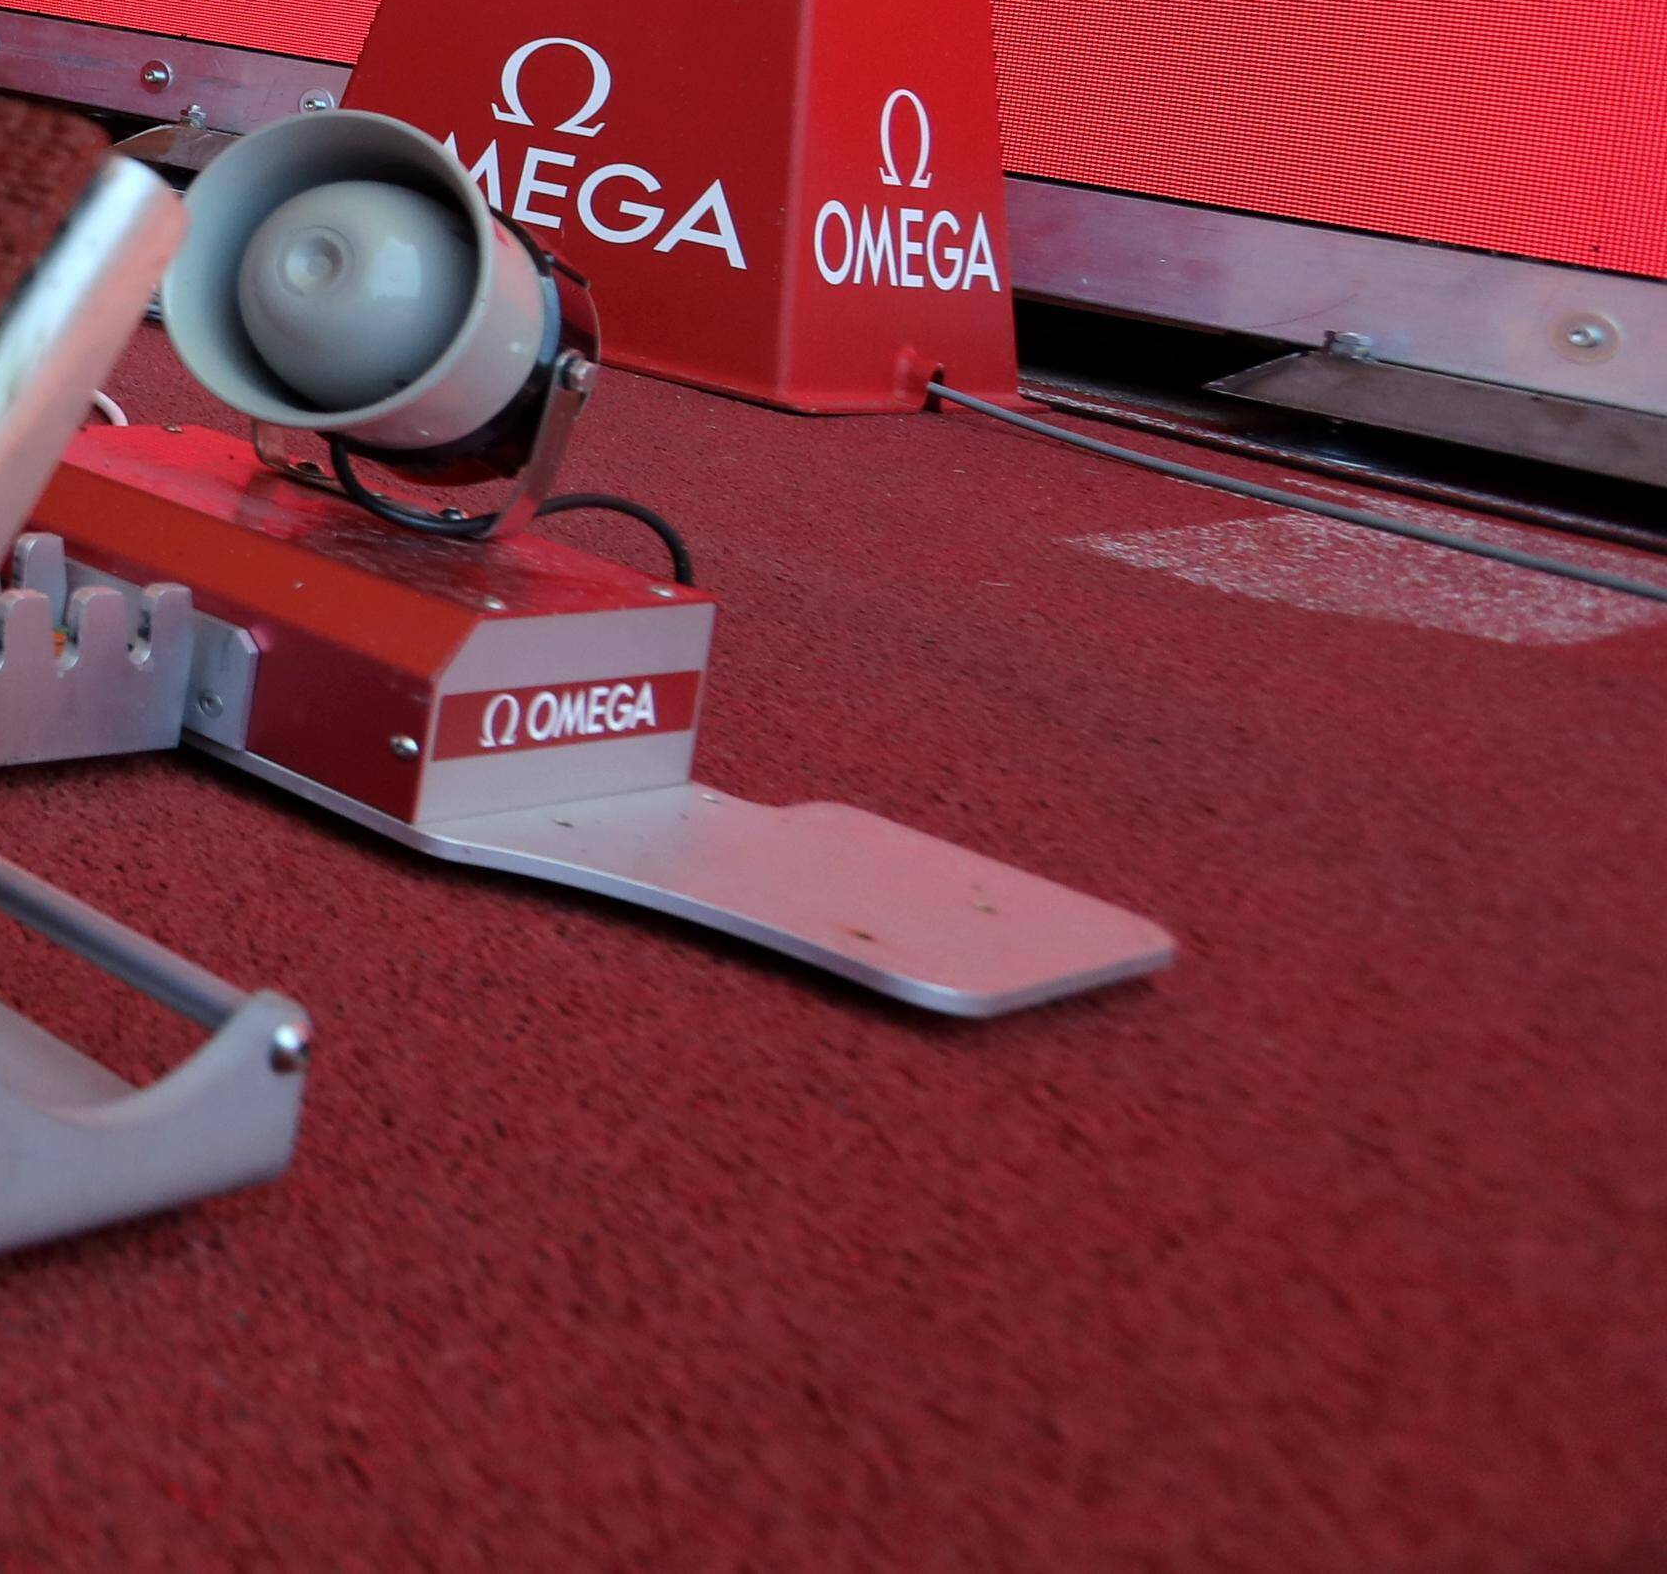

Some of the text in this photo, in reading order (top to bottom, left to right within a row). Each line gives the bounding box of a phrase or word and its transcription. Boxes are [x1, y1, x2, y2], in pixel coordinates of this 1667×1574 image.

[442, 130, 747, 270] MEGA
[815, 200, 1000, 291] OMEGA
[525, 681, 658, 743] OMEGA
